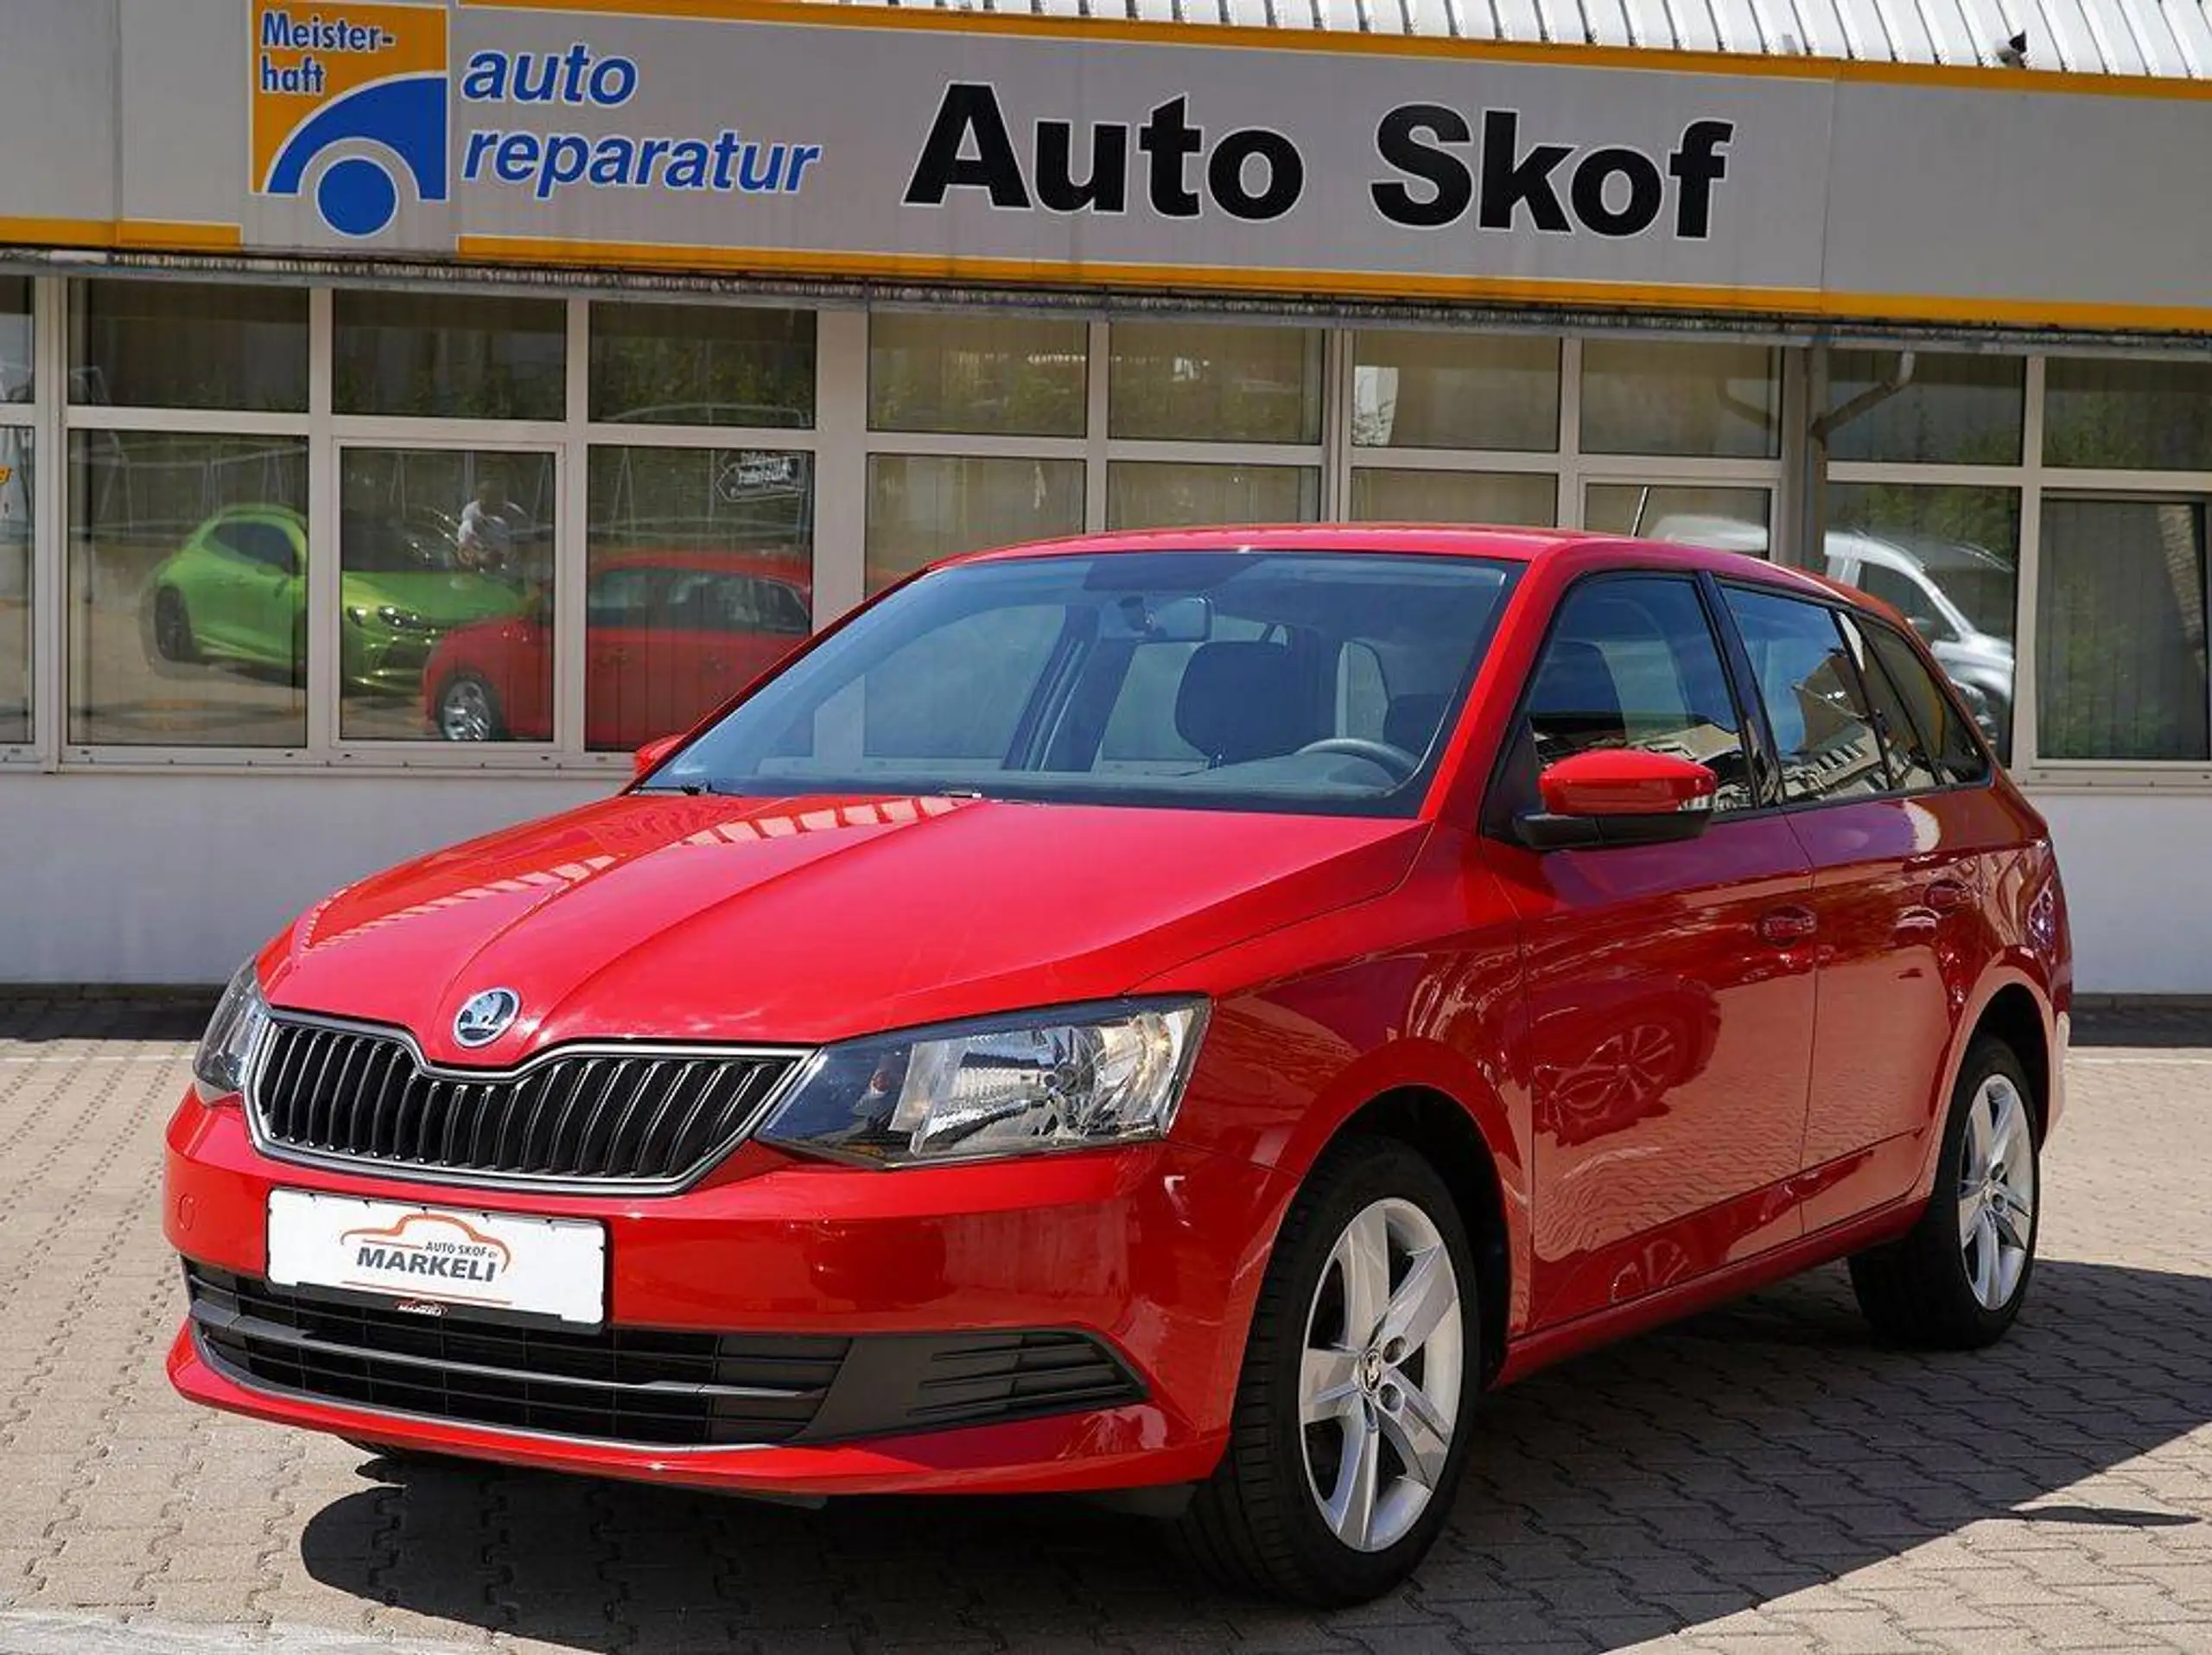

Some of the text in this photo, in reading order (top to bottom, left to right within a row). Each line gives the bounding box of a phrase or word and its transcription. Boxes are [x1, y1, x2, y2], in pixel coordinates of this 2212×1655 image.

[262, 12, 394, 50] Meister-
[262, 57, 325, 92] haft
[464, 44, 637, 106] auto
[464, 130, 820, 198] reparatur
[902, 80, 1733, 239] Auto Skof
[357, 1246, 496, 1282] MARKELI
[424, 1241, 455, 1255] AUTO
[458, 1244, 487, 1257] SKOF
